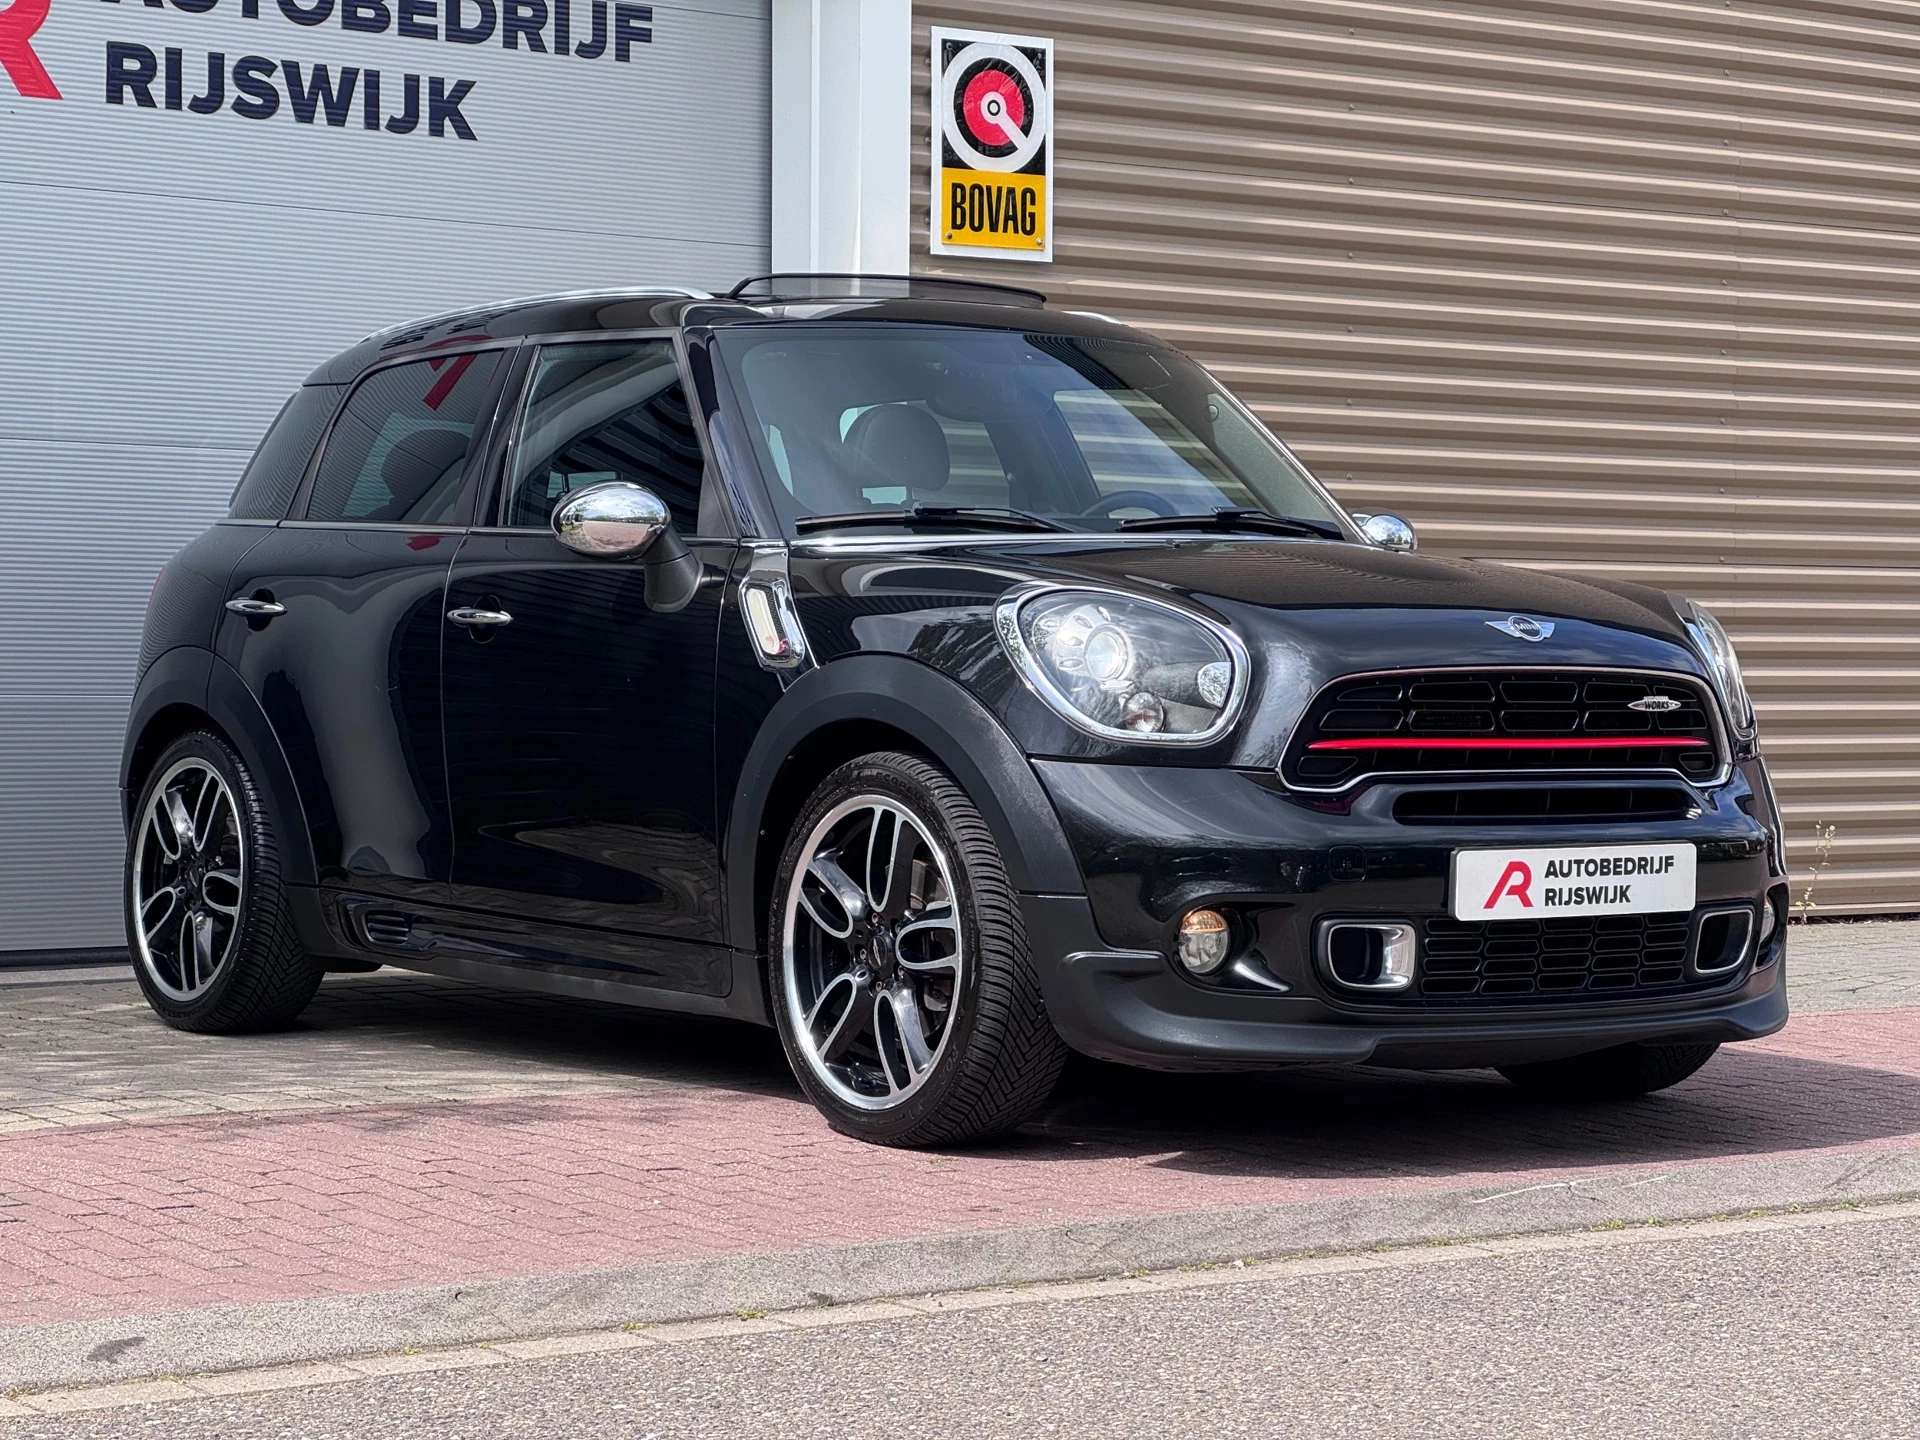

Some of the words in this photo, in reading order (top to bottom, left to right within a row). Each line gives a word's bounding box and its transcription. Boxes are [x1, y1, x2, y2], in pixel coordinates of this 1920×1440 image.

[94, 0, 653, 62] BEDRIJF
[106, 41, 478, 141] RIJSWIJK
[951, 182, 1036, 236] BOVAG
[1644, 701, 1670, 710] WORKS
[1544, 855, 1675, 879] AUTOBEDRIJF
[1544, 884, 1632, 907] RIJSWIJK
